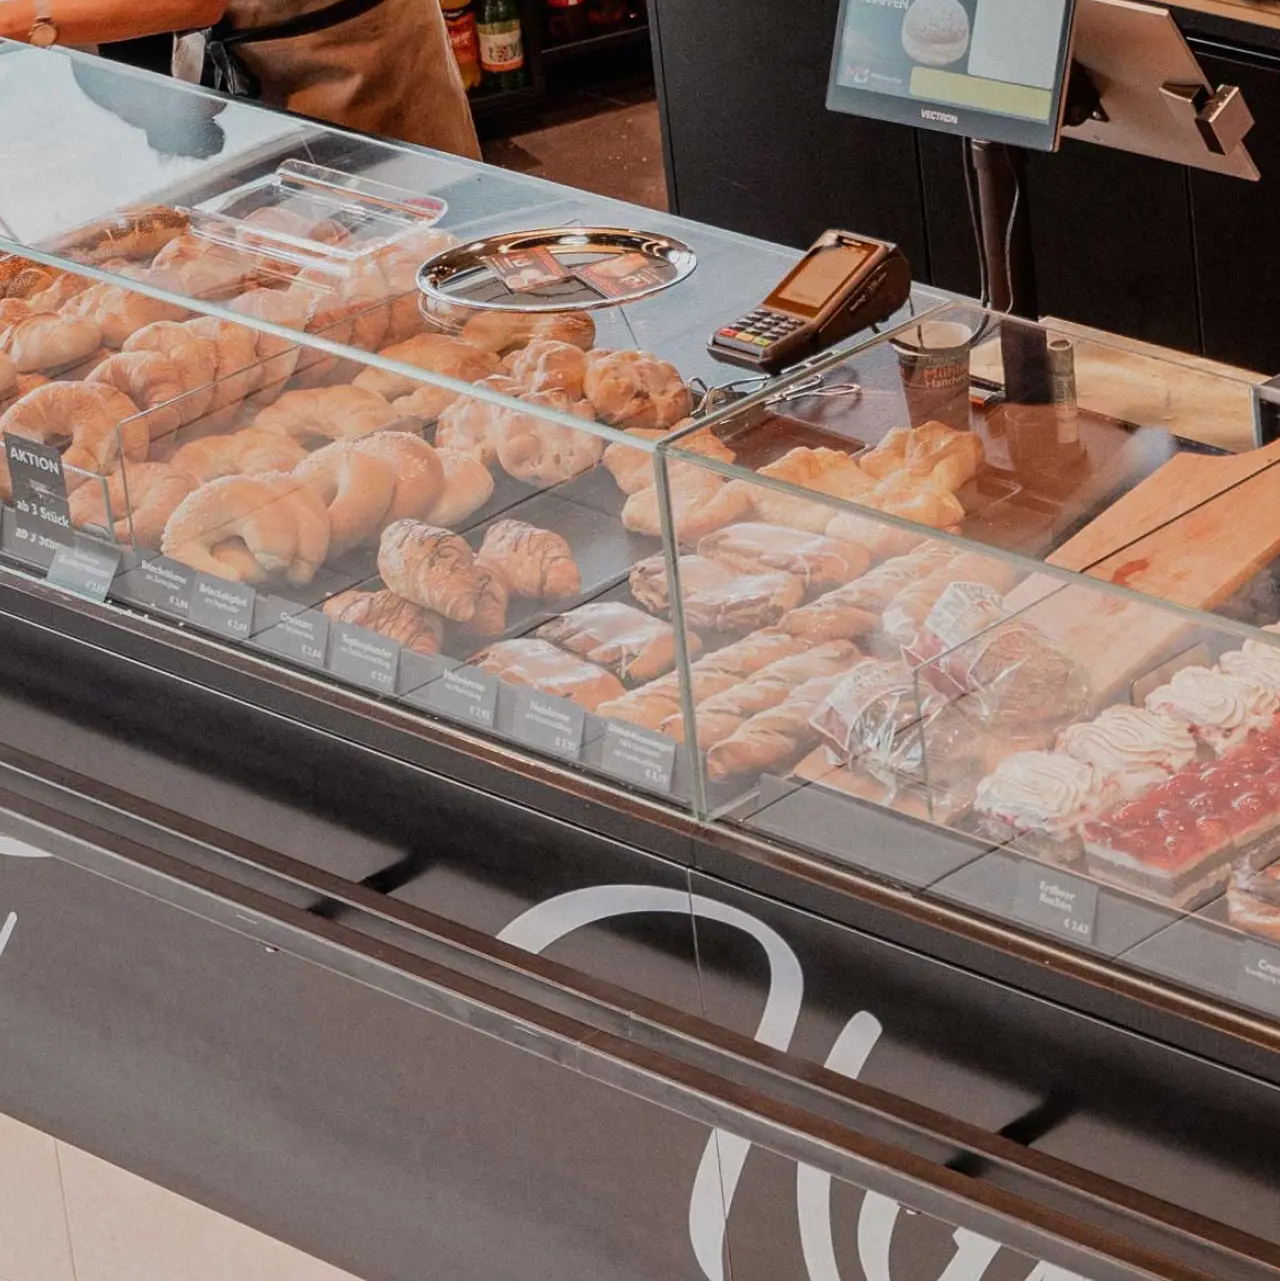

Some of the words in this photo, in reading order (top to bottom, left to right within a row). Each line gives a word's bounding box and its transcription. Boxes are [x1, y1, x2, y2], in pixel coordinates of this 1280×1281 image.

[921, 108, 958, 124] VECTRON
[10, 447, 59, 475] AKTION
[17, 500, 29, 513] ab
[31, 503, 37, 515] 3
[40, 506, 69, 528] Stück
